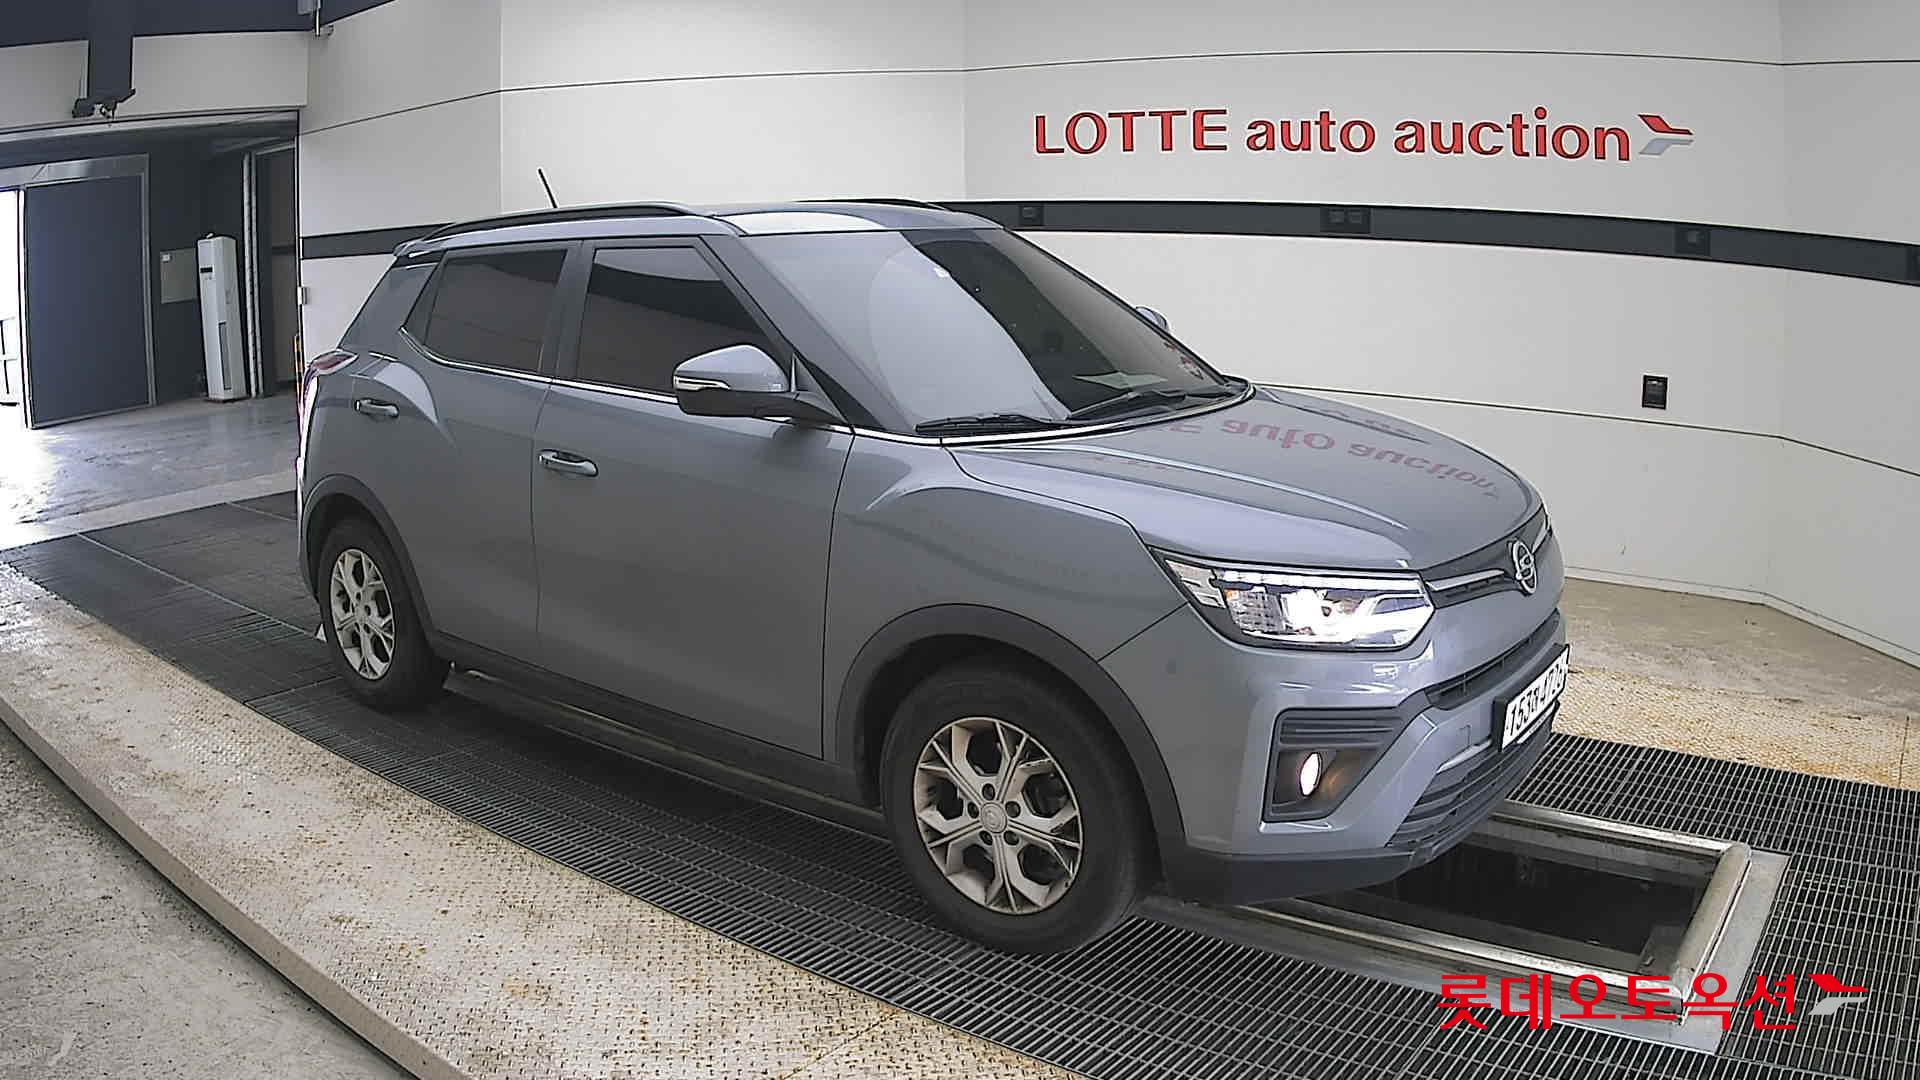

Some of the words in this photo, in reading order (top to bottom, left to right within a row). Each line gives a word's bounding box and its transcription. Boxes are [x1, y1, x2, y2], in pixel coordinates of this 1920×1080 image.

[1034, 108, 1228, 155] LOTTE
[1245, 110, 1376, 153] auto
[1393, 106, 1631, 162] auction
